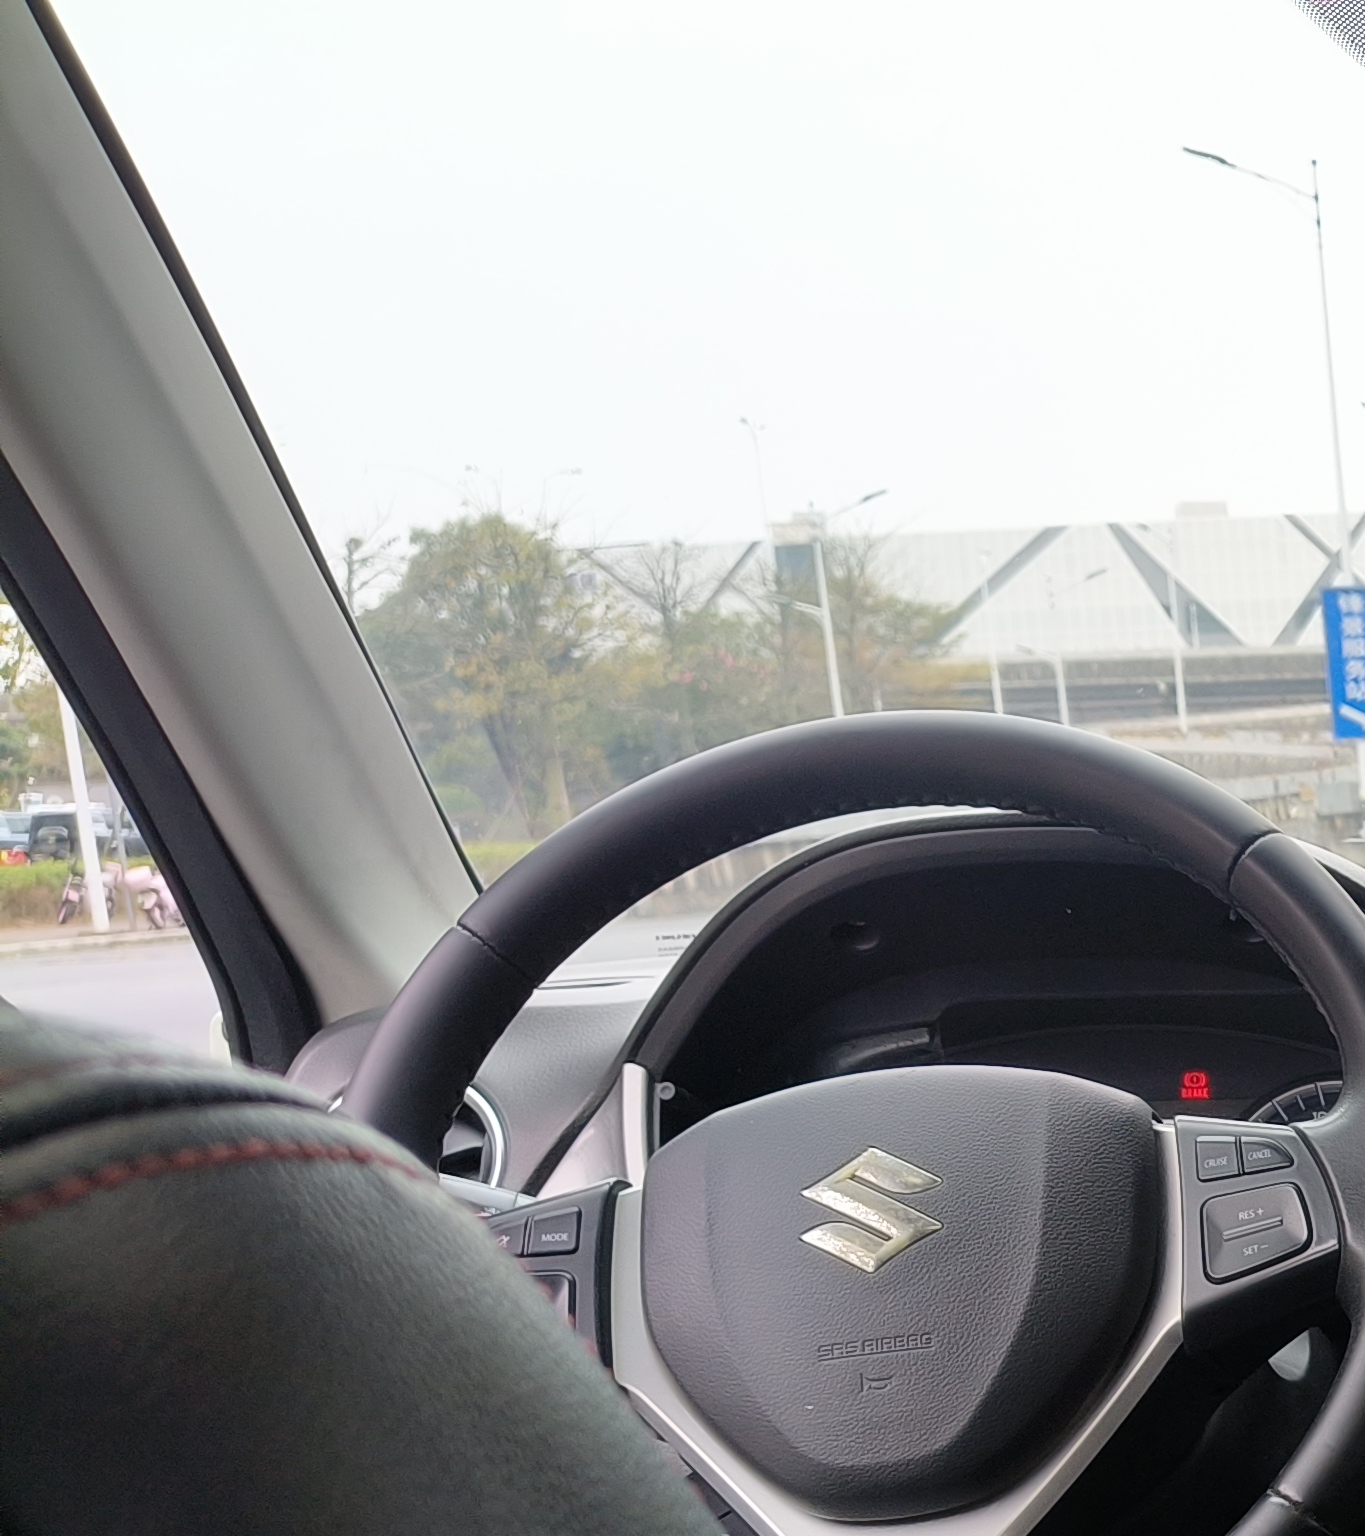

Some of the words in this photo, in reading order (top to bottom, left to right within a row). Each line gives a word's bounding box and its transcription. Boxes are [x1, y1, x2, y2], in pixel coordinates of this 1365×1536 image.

[1181, 1088, 1210, 1099] BRAKE
[1247, 1149, 1272, 1161] CANCEL
[1203, 1156, 1228, 1169] CRUISE
[1238, 1209, 1256, 1221] RES
[540, 1232, 569, 1242] MODE
[1242, 1245, 1259, 1256] SET
